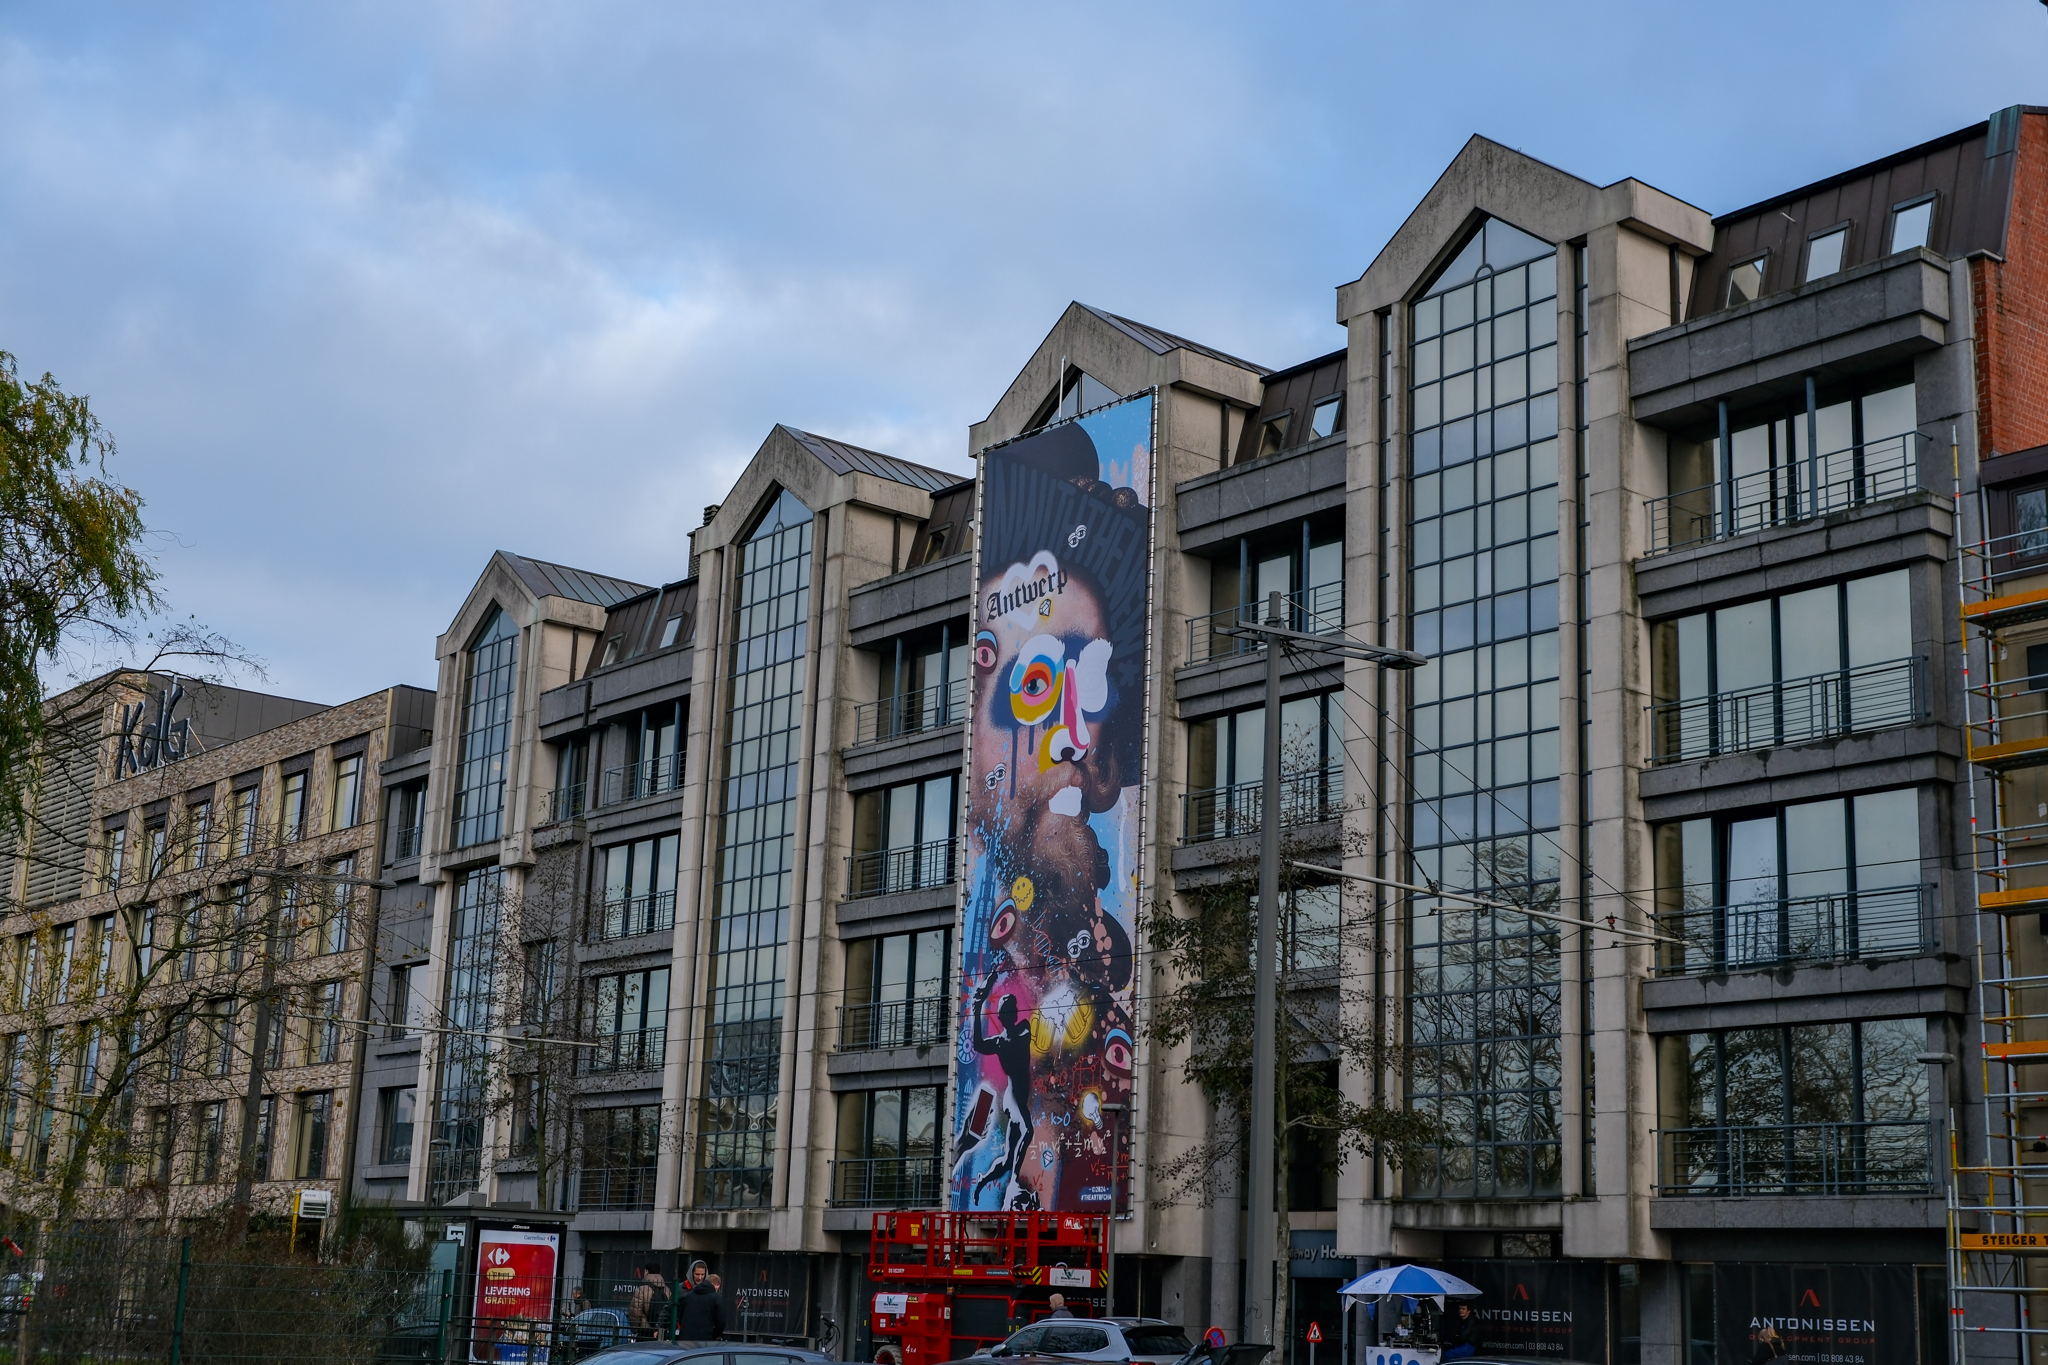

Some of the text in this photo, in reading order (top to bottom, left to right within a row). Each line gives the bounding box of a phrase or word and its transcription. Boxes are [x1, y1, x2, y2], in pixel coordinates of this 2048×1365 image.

[987, 568, 1067, 622] Antwerp
[115, 680, 190, 780] KdG
[1982, 1235, 2037, 1245] STEIGER
[485, 1286, 531, 1296] LEVERING
[736, 1288, 790, 1298] ANTONISSEN
[1750, 1316, 1876, 1332] ANTONISSEN
[1821, 1354, 1830, 1362] 03
[1831, 1354, 1844, 1363] 808
[1845, 1355, 1854, 1363] 43
[1855, 1355, 1864, 1364] 84
